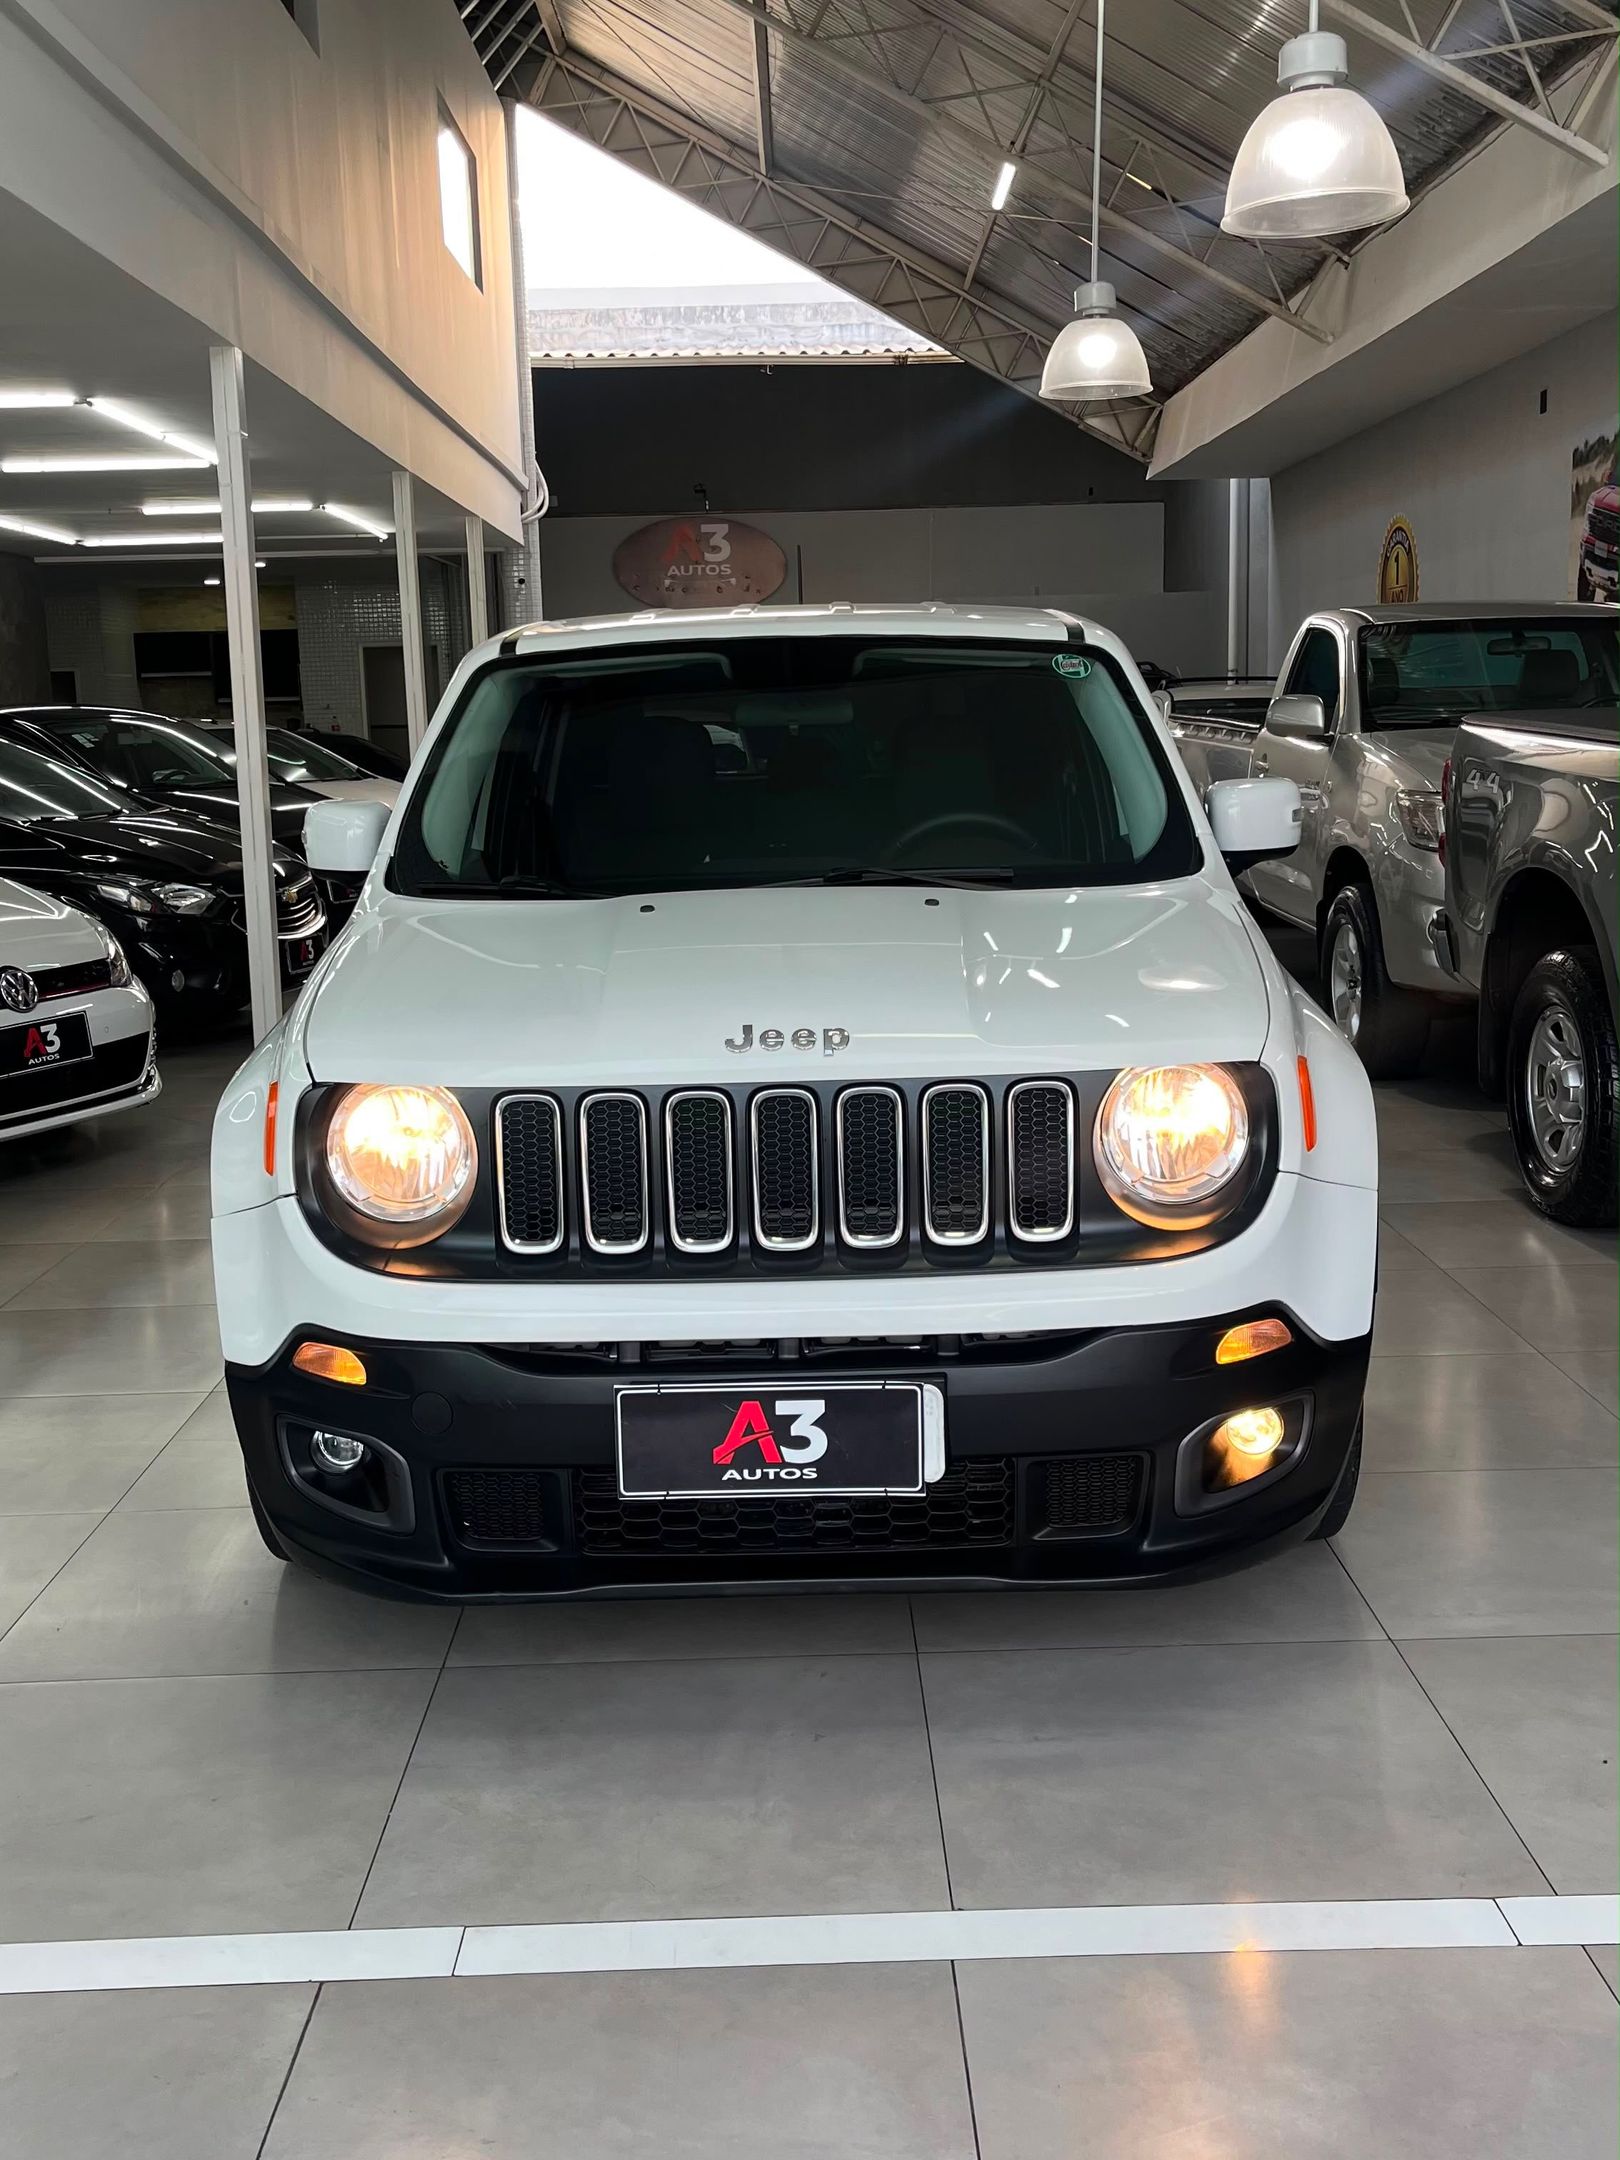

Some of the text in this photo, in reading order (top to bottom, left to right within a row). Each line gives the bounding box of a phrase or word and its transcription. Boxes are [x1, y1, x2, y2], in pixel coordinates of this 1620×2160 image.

[660, 523, 732, 563] A3
[667, 564, 732, 577] AUTOS
[24, 1023, 61, 1057] A3
[724, 1024, 850, 1057] Jeep
[28, 1053, 60, 1065] AUTOS
[712, 1399, 829, 1465] A3
[721, 1467, 818, 1481] AUTOS
